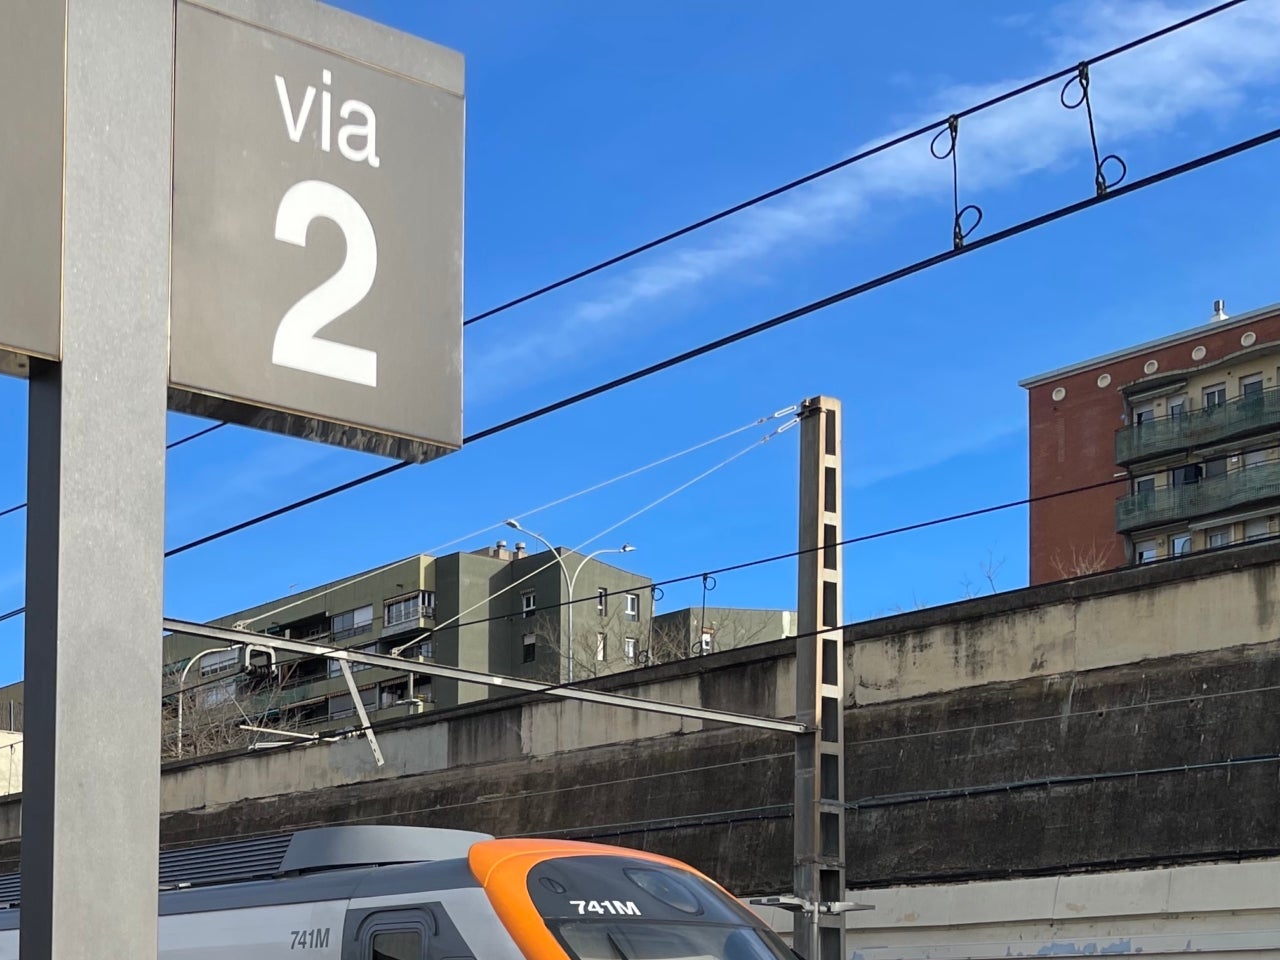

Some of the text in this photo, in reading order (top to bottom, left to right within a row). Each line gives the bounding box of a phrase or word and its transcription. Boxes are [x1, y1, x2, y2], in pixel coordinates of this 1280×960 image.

[274, 69, 381, 168] via
[271, 180, 378, 387] 2
[290, 927, 330, 950] 741M
[569, 900, 642, 916] 741M
